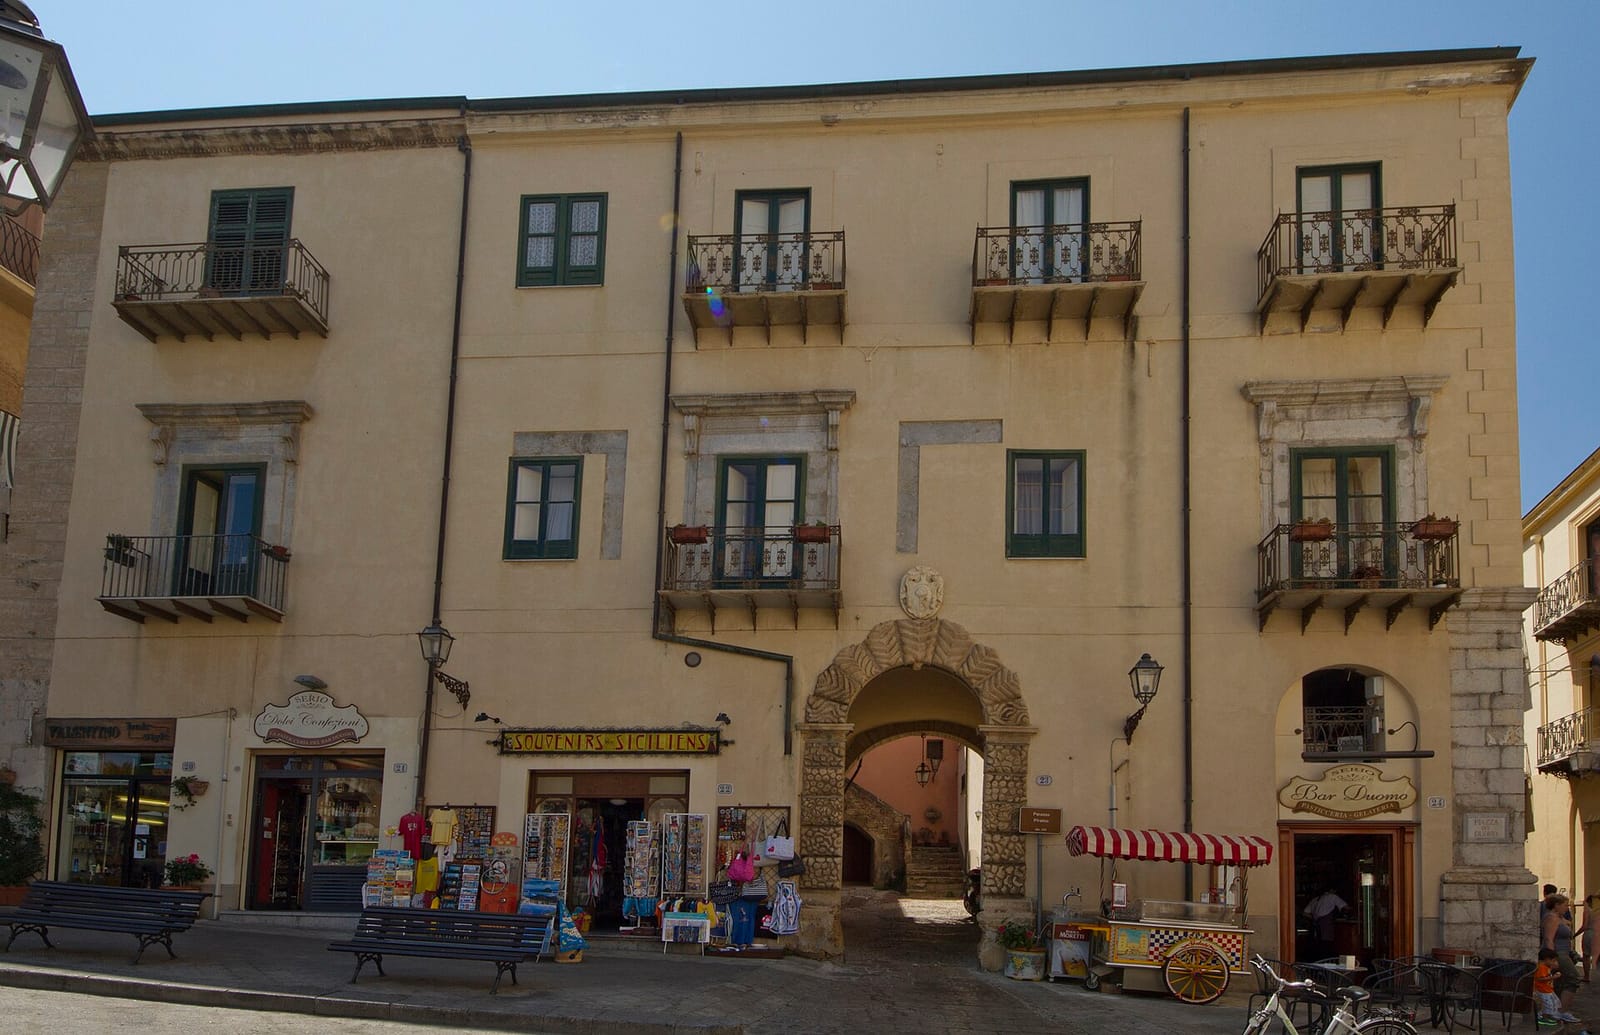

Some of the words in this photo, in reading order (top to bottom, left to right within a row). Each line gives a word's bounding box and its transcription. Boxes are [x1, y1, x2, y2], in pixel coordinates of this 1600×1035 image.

[295, 695, 329, 704] SERIO
[263, 712, 295, 726] Dolci
[298, 712, 361, 730] Confezioni
[48, 725, 121, 739] VALENTINO
[514, 734, 604, 751] SOUVENIRS
[616, 734, 706, 751] SICILIENS
[1331, 767, 1375, 776] SERIO
[1291, 784, 1337, 801] Bar
[1343, 784, 1408, 801] Duomo
[1301, 803, 1349, 819] PASTICCERIA
[1353, 803, 1396, 818] GELATERIA
